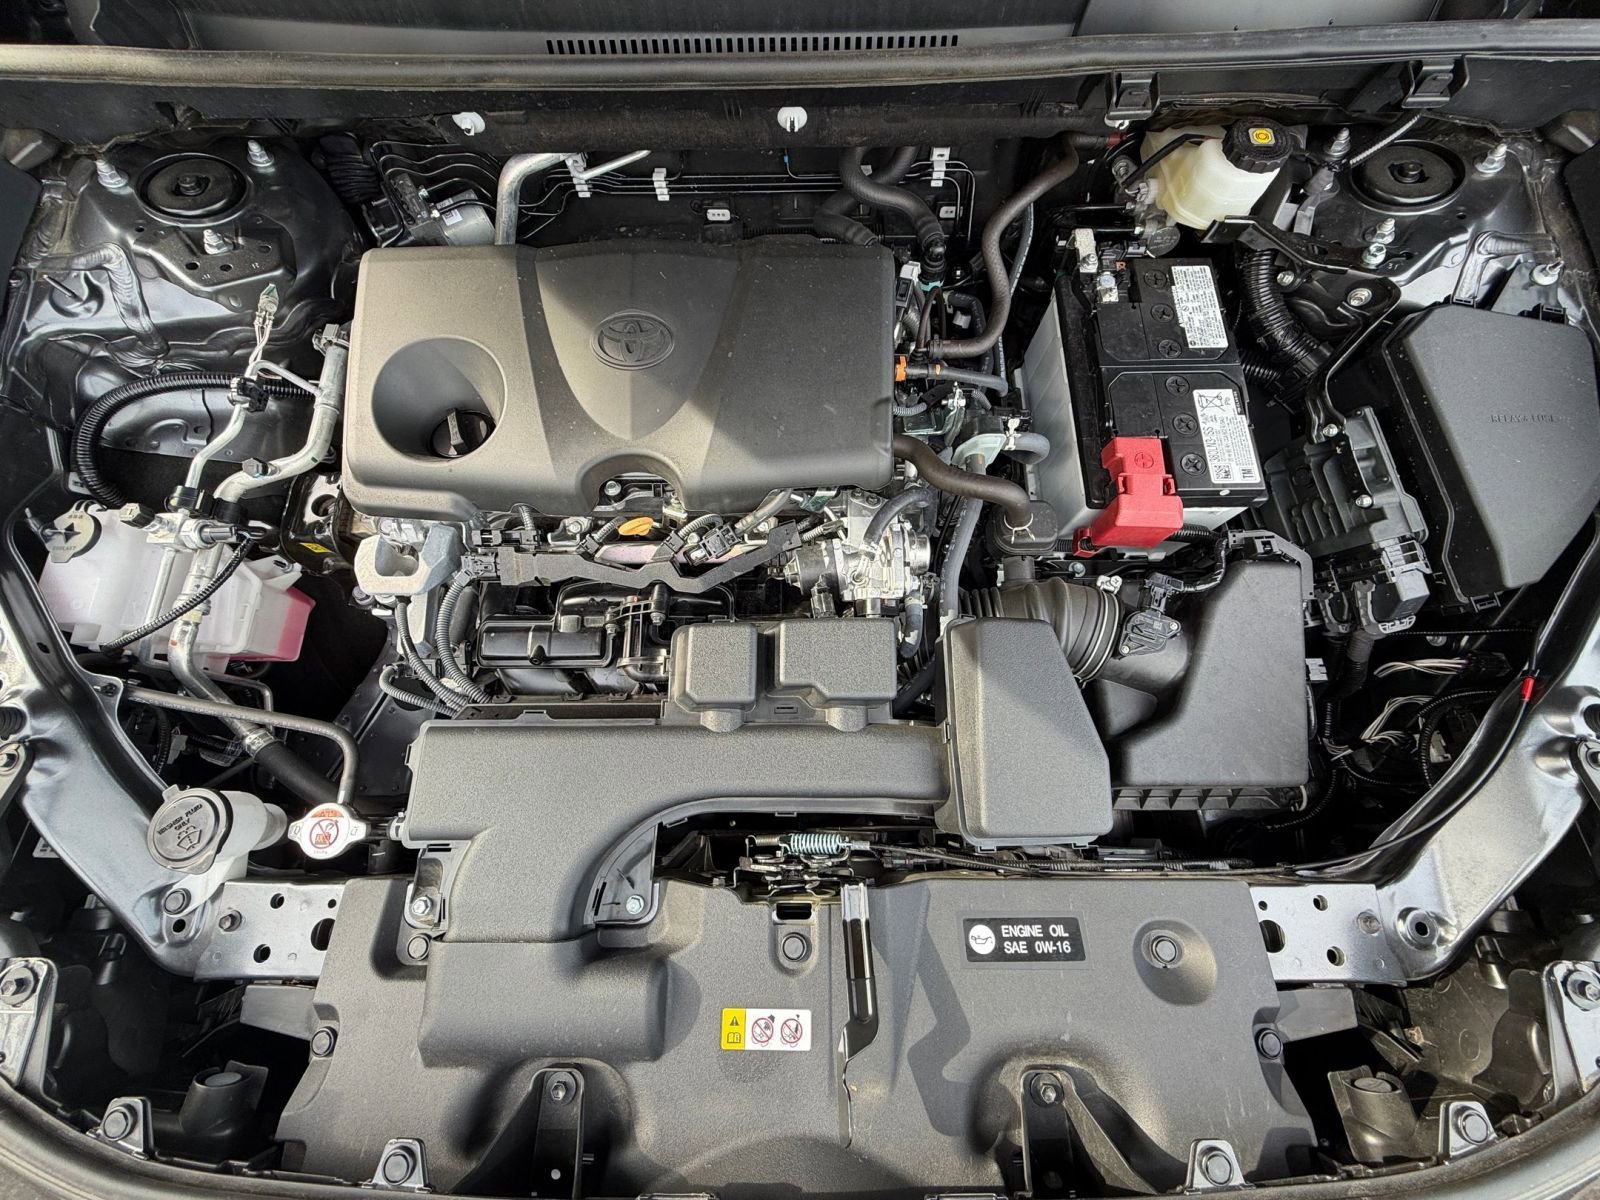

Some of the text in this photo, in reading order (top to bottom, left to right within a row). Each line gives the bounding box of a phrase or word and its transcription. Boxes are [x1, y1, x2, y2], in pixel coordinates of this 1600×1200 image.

[1001, 924, 1069, 938] ENGINE OIL
[1004, 940, 1071, 954] SAE 0W-16
